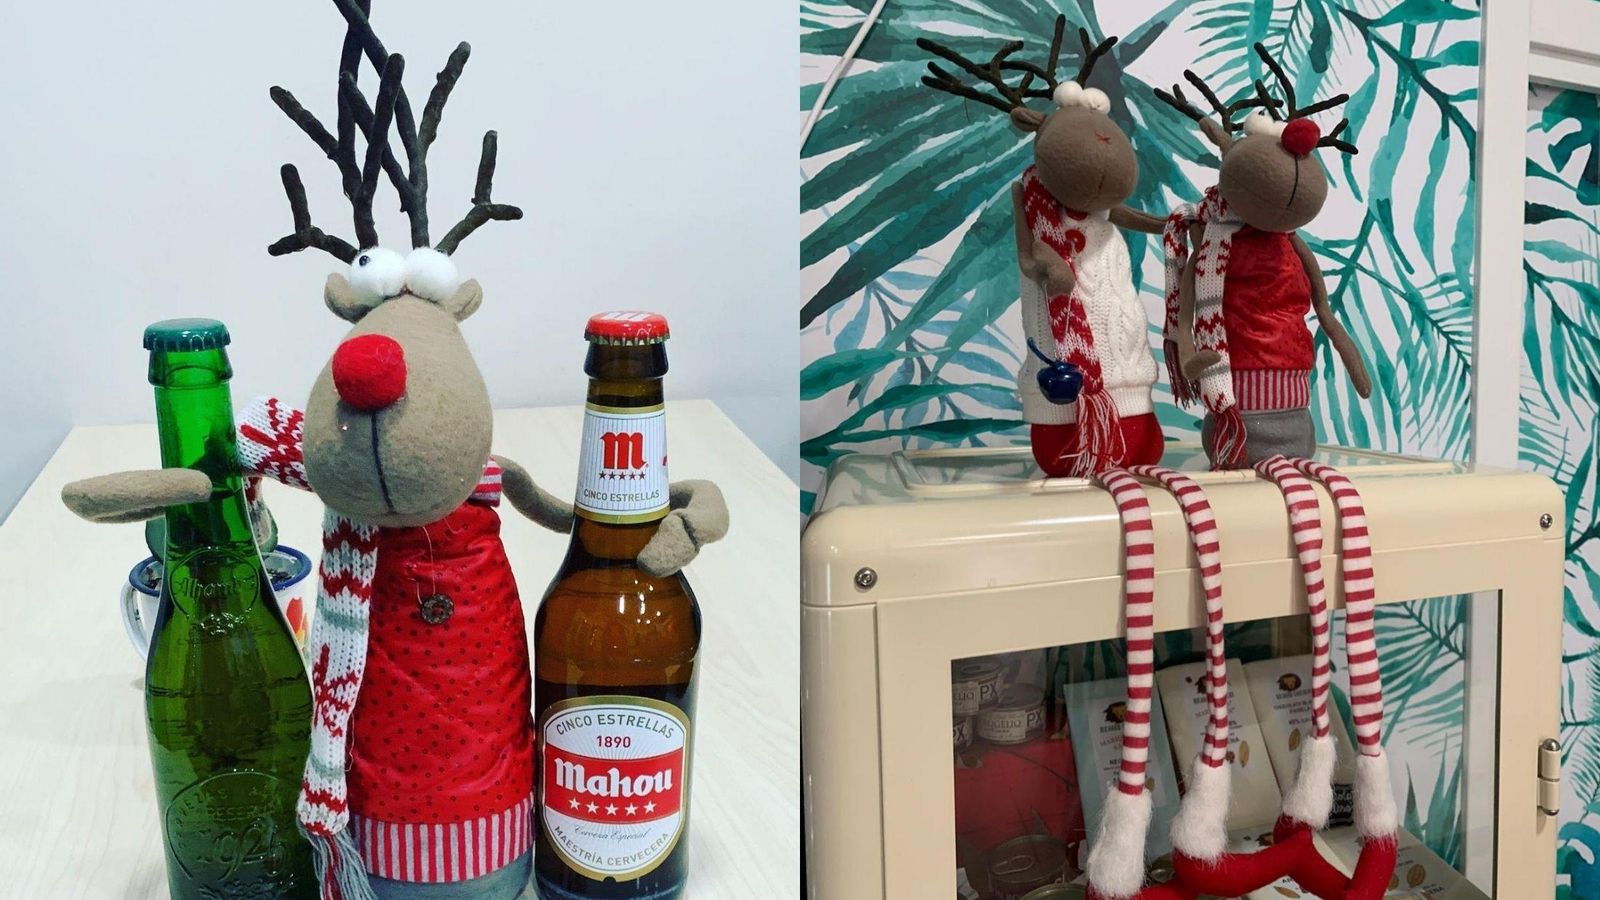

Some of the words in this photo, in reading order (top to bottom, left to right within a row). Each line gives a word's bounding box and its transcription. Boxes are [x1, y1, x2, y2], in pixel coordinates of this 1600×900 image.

[583, 488, 608, 501] CINCO
[610, 489, 660, 502] ESTRELLAS
[556, 714, 593, 735] CINCO
[598, 714, 675, 739] ESTRELLAS
[596, 735, 631, 748] 1890
[554, 757, 673, 798] Mahou
[554, 826, 604, 865] MAESTRÍA
[607, 832, 669, 866] CERVECERA
